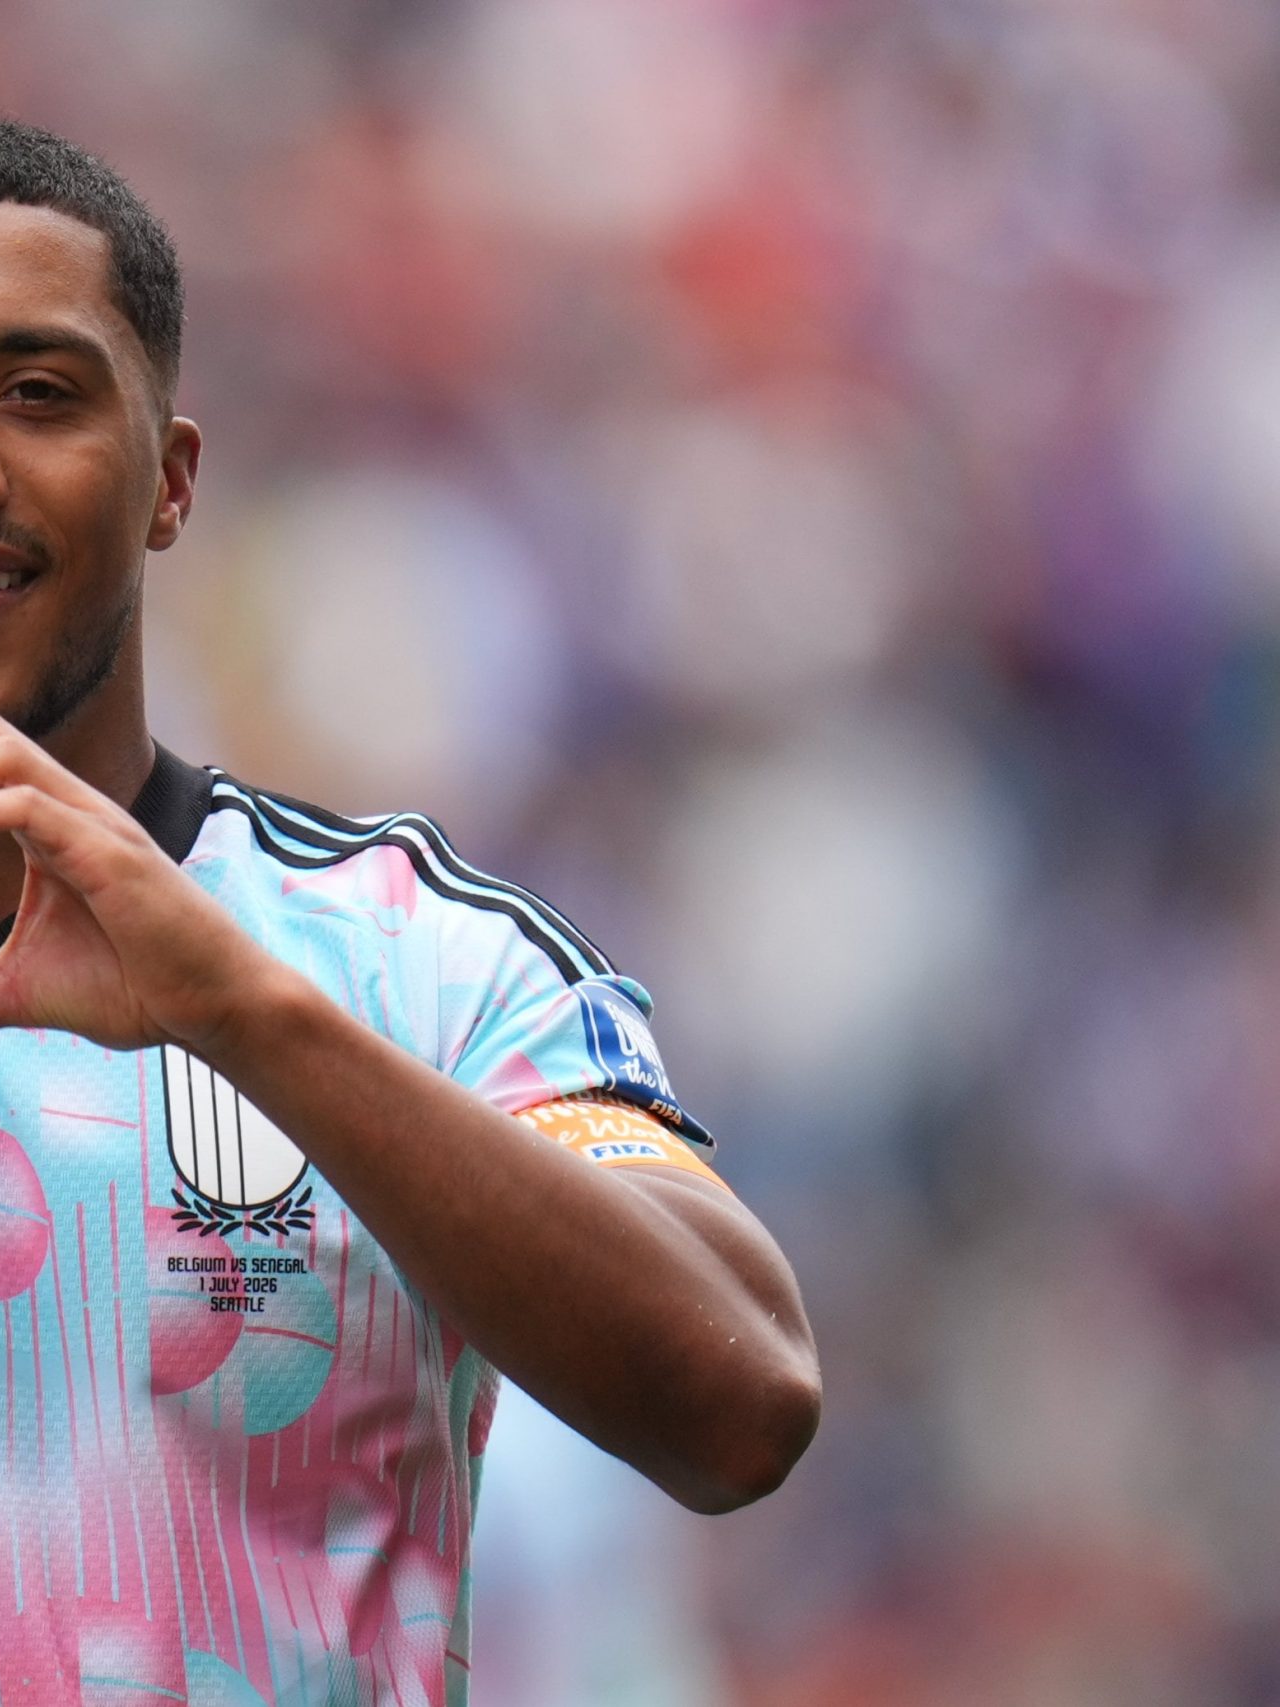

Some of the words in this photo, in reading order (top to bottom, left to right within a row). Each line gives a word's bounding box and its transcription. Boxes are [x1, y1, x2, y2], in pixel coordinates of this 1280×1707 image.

[619, 1057, 657, 1088] the
[648, 1098, 683, 1126] FIFA
[591, 1143, 661, 1159] FIFA
[167, 1256, 226, 1273] BELGIUM
[230, 1257, 247, 1273] VS
[251, 1257, 307, 1274] SENEGAL
[199, 1276, 205, 1292] 1
[208, 1276, 240, 1293] JULY
[243, 1277, 278, 1293] 2026
[210, 1296, 265, 1313] SEATTLE
